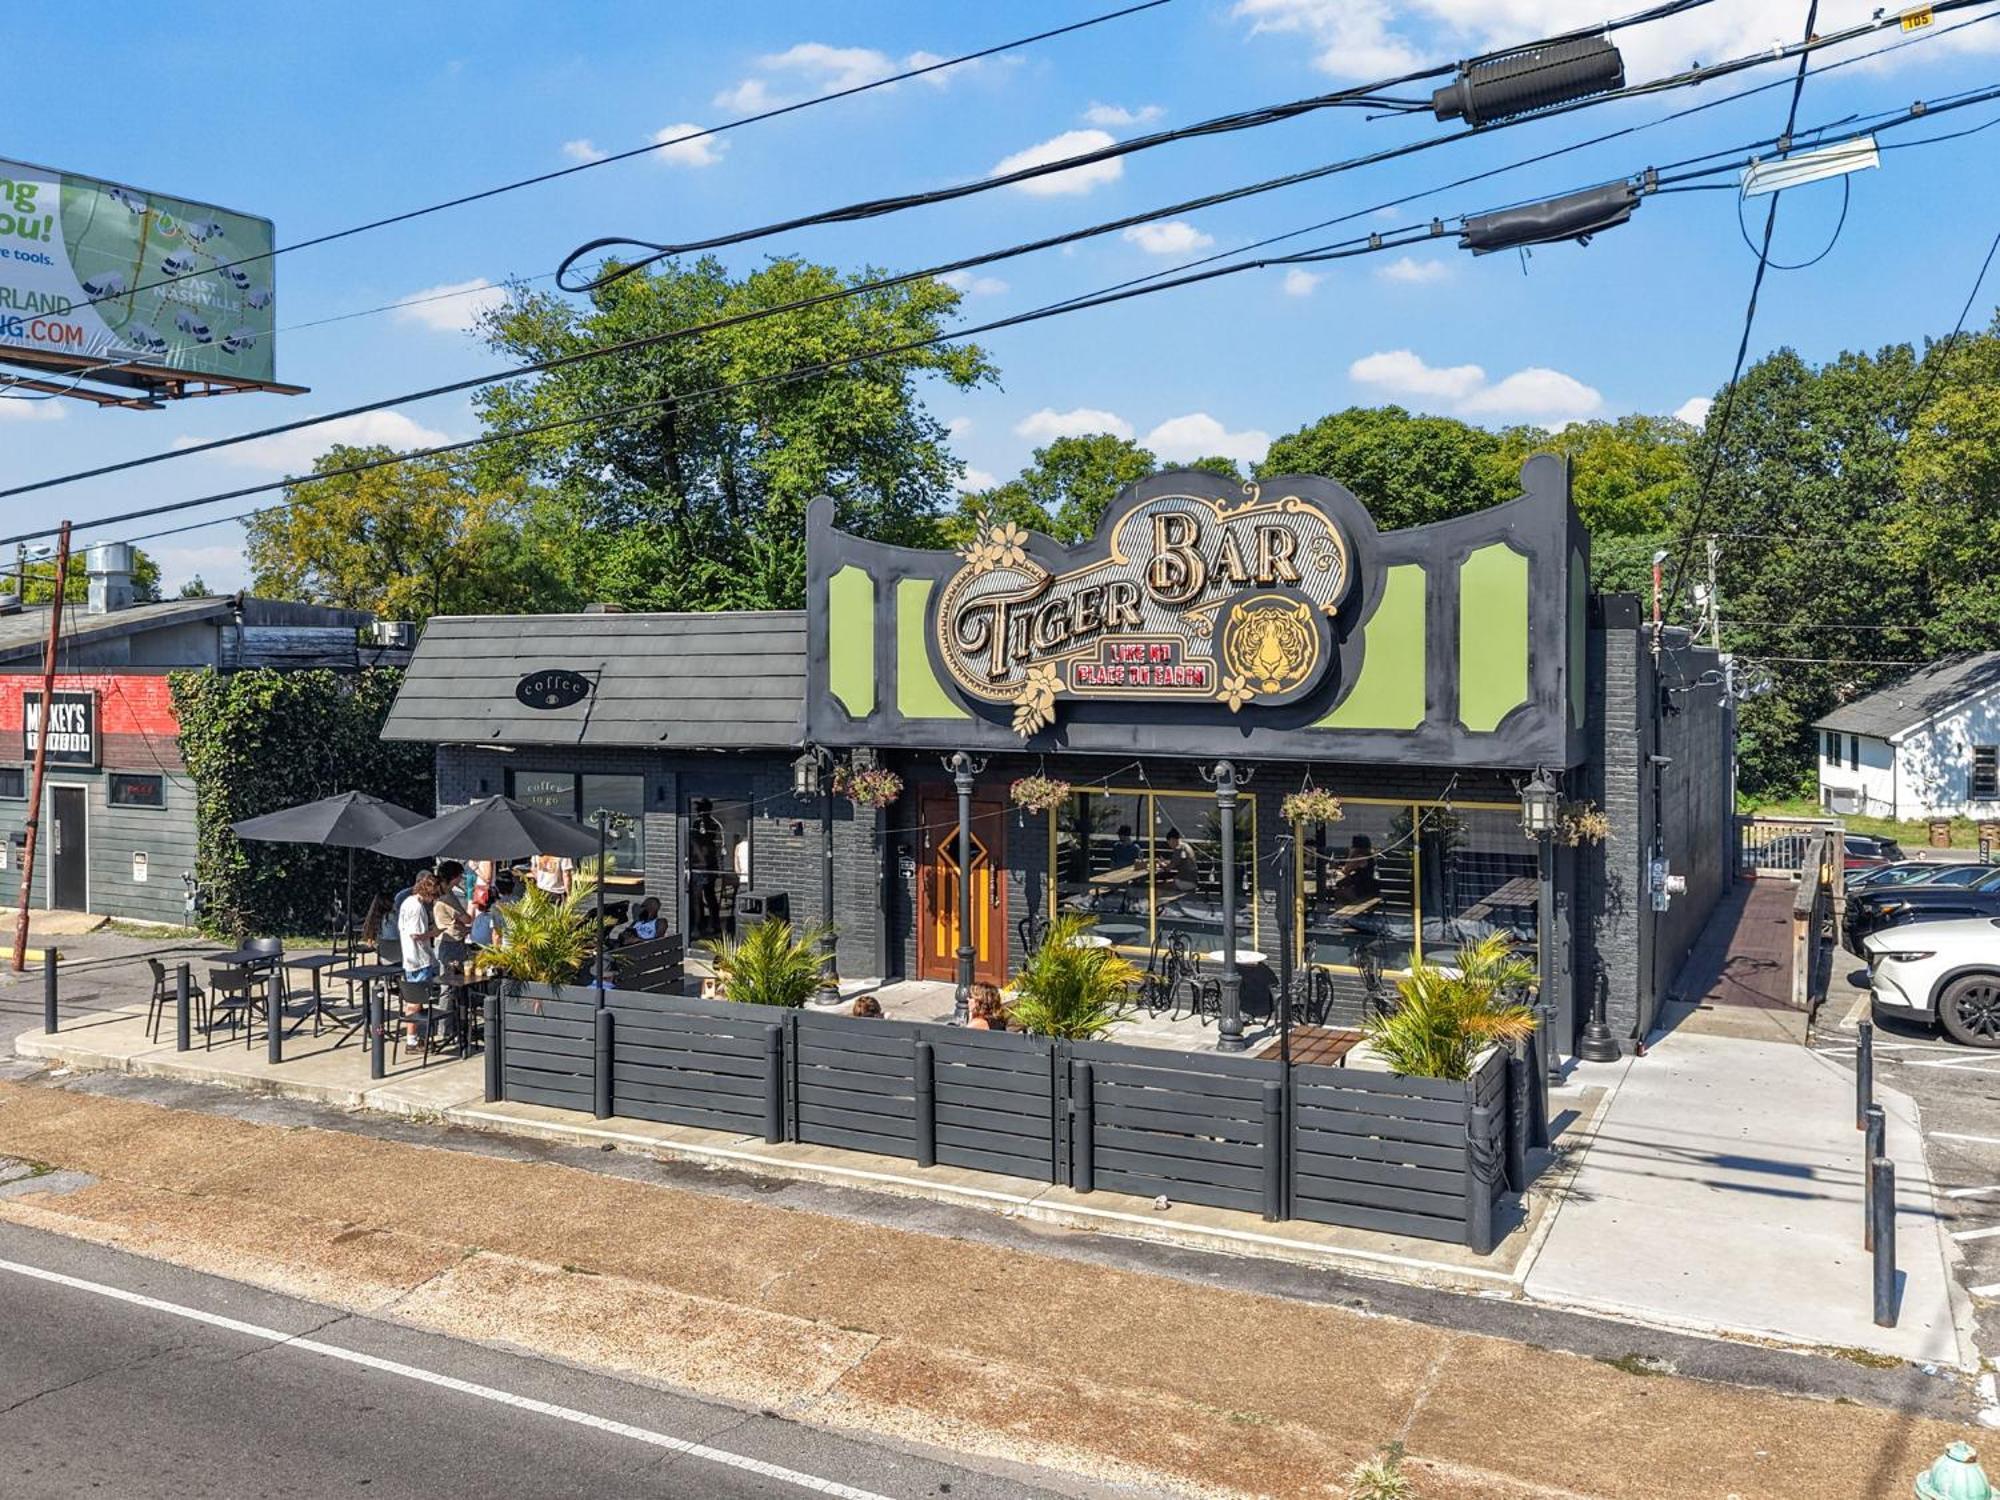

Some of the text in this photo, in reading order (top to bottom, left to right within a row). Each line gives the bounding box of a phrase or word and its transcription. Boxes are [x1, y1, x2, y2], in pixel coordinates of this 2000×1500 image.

[14, 250, 54, 266] tools.
[153, 286, 241, 313] NASHVILLE
[955, 511, 1301, 680] TIGER BAR
[1111, 644, 1171, 663] LIKE NO
[1077, 665, 1206, 685] PLACE ON EARTH
[524, 676, 581, 696] coffee
[27, 703, 85, 733] MKEY'S
